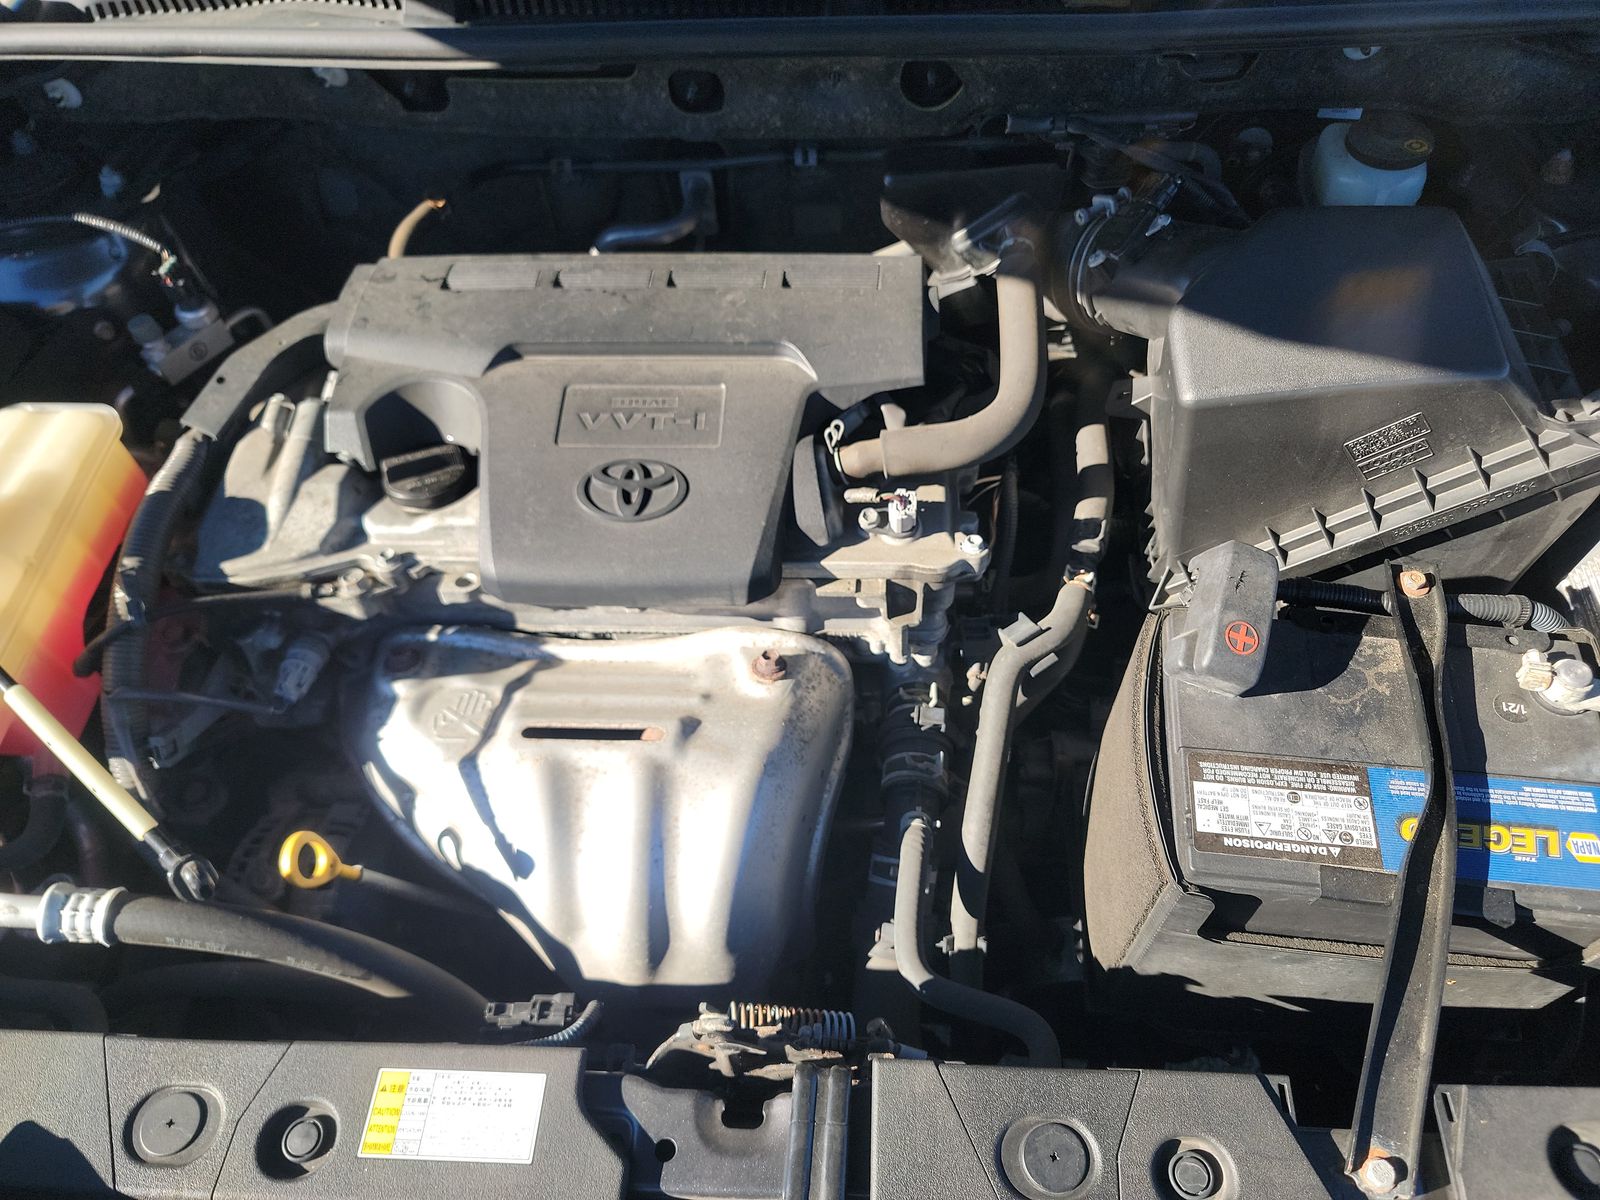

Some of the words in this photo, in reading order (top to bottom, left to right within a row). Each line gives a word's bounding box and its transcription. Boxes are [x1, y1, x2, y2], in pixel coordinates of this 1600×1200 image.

[1502, 702, 1527, 715] 1/21
[1293, 770, 1316, 778] FOLLOW
[1196, 803, 1218, 811] MEDICAL
[1224, 837, 1327, 855] DANGER/POISON
[1572, 840, 1600, 855] NAPA
